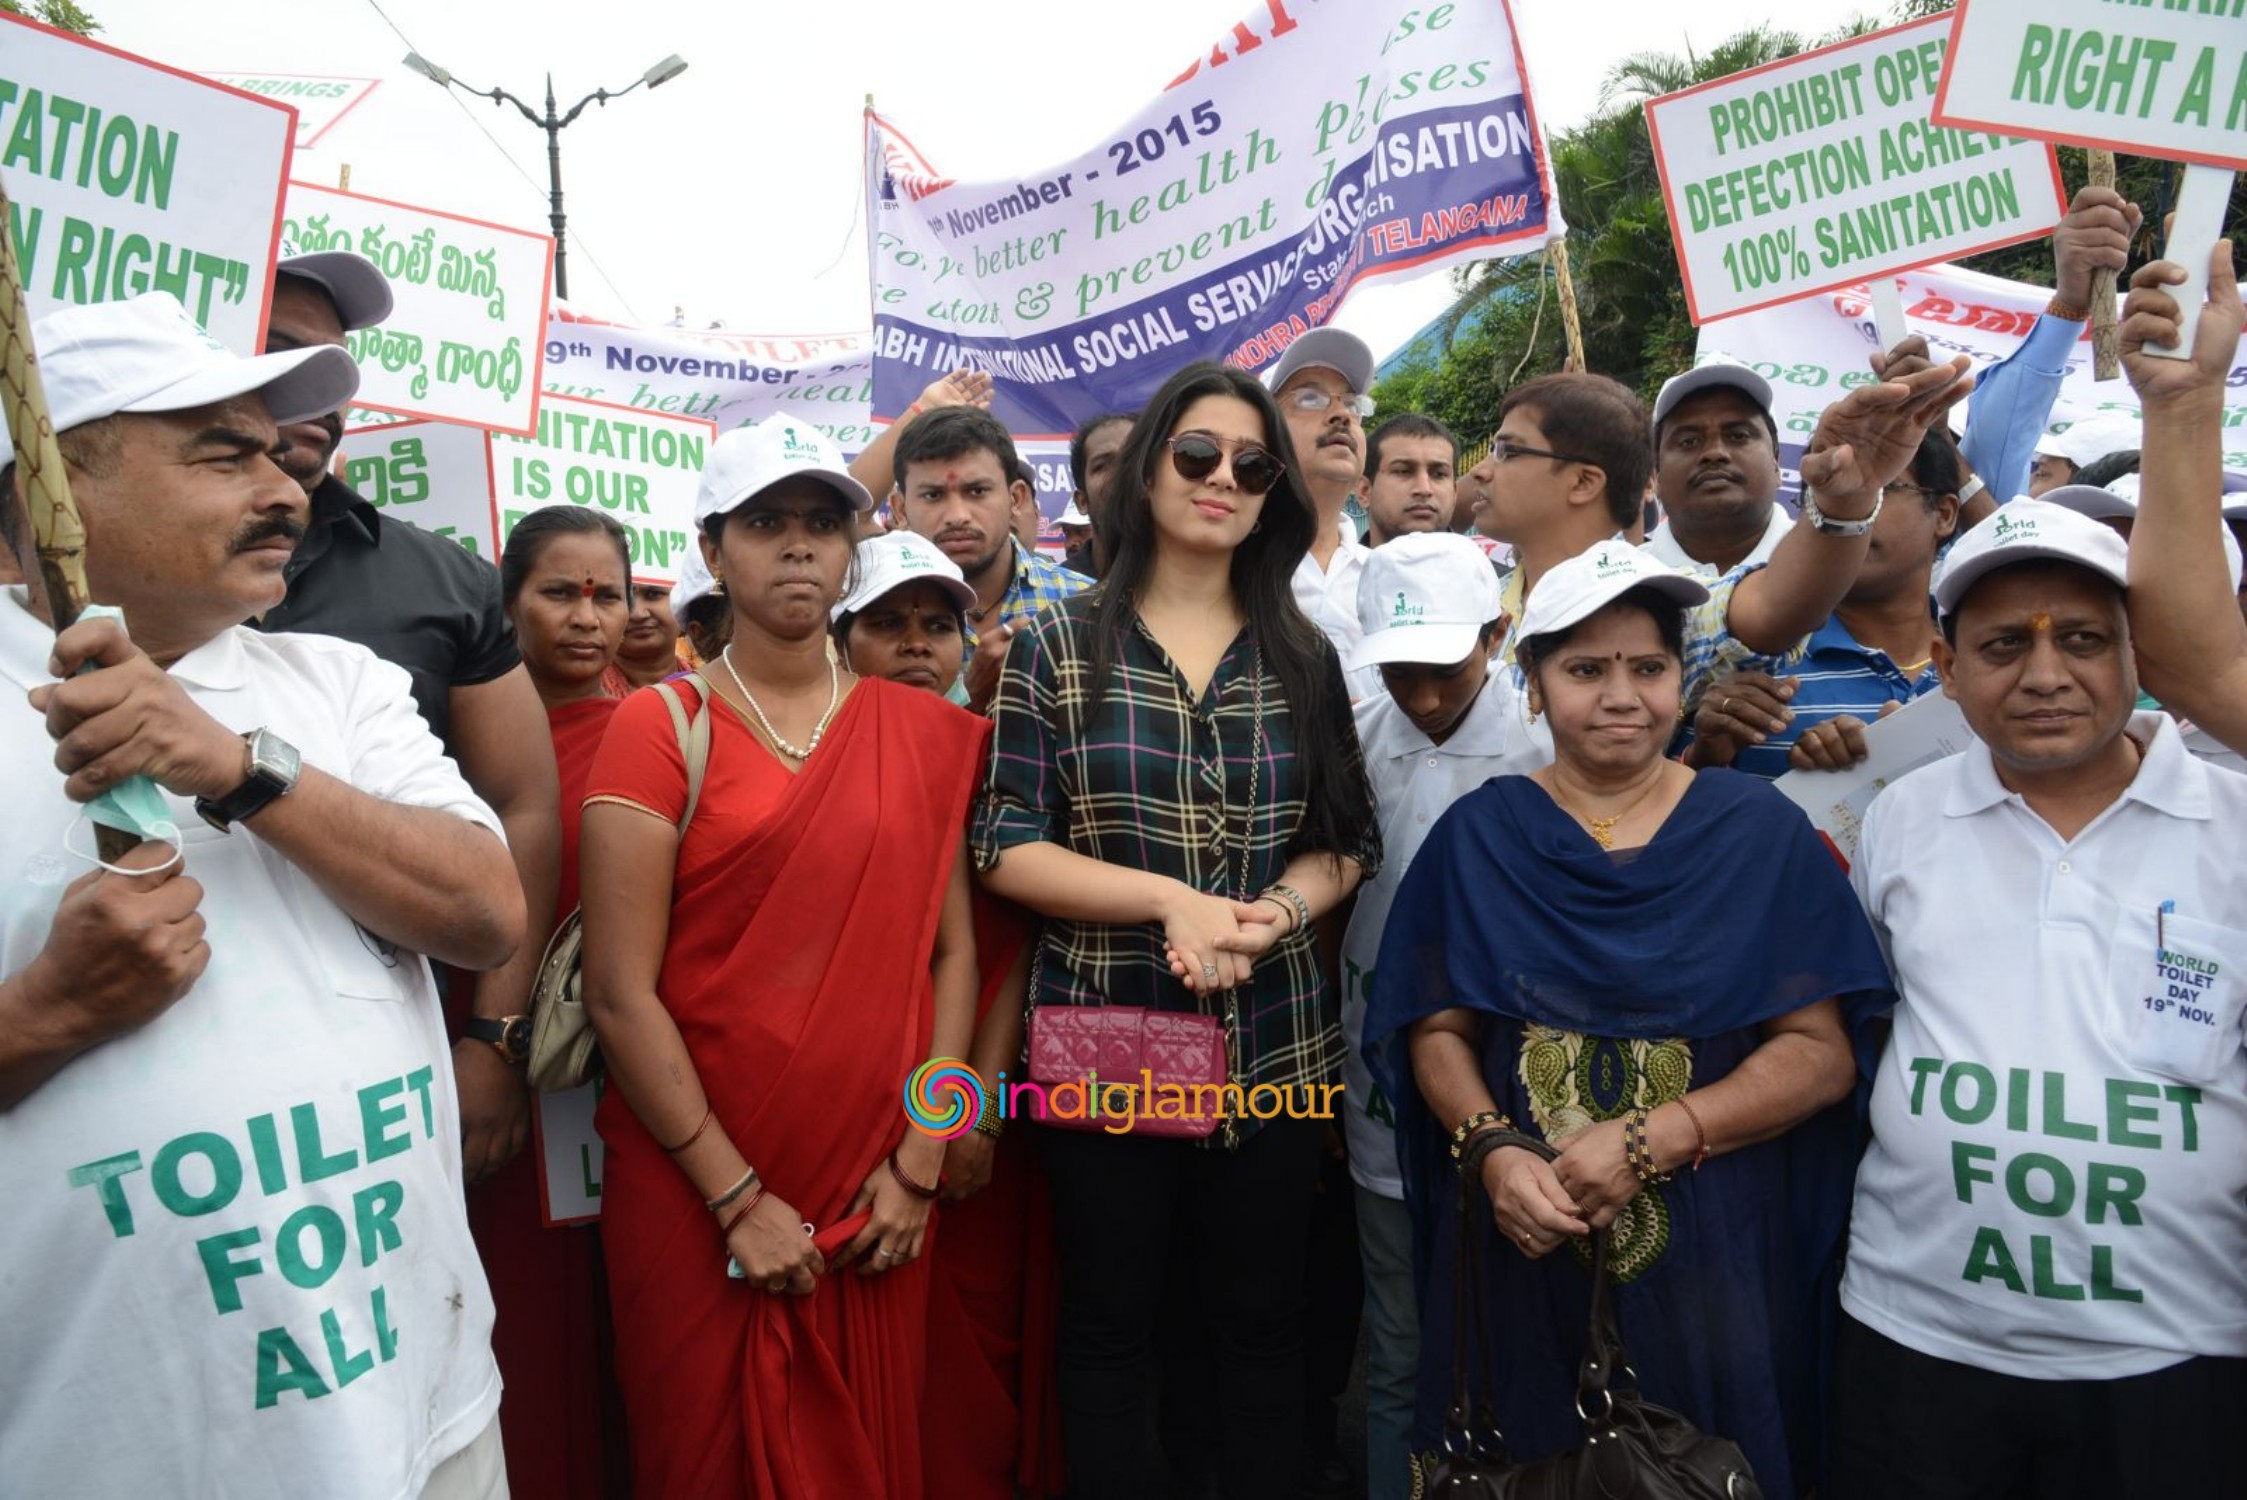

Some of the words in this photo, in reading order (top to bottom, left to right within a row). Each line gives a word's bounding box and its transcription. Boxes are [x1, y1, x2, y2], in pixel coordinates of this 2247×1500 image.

[1709, 63, 1864, 156] PROHIBIT
[1874, 37, 1947, 107] OPE
[2010, 23, 2177, 119] RIGHT
[2172, 46, 2216, 127] A
[949, 173, 1073, 238] November
[1108, 100, 1222, 176] 2015
[973, 227, 1067, 278] better
[1091, 129, 1281, 240] health
[1684, 136, 1871, 234] DEFECTION
[1879, 117, 2033, 182] ACHIE
[1015, 282, 1055, 321] &
[1076, 197, 1278, 318] prevent
[1368, 194, 1527, 257] TELANGANA
[1722, 225, 1811, 293] 100%
[1814, 168, 2021, 269] SANITATION
[1303, 248, 1348, 290] Stat
[605, 345, 799, 384] November
[1073, 306, 1189, 374] SOCIAL
[493, 408, 704, 472] NITATION
[513, 456, 551, 500] IS
[565, 465, 651, 514] OUR
[2156, 963, 2214, 989] TOILET
[2160, 950, 2220, 976] WORLD
[2168, 984, 2200, 1003] DAY
[2179, 1005, 2216, 1026] NOV.
[1909, 1057, 2202, 1152] TOILET
[66, 1064, 434, 1238] TOILET
[1952, 1140, 2146, 1226] FOR
[196, 1180, 404, 1315] FOR
[1962, 1226, 2143, 1304] ALL
[255, 1285, 398, 1410] ALL
